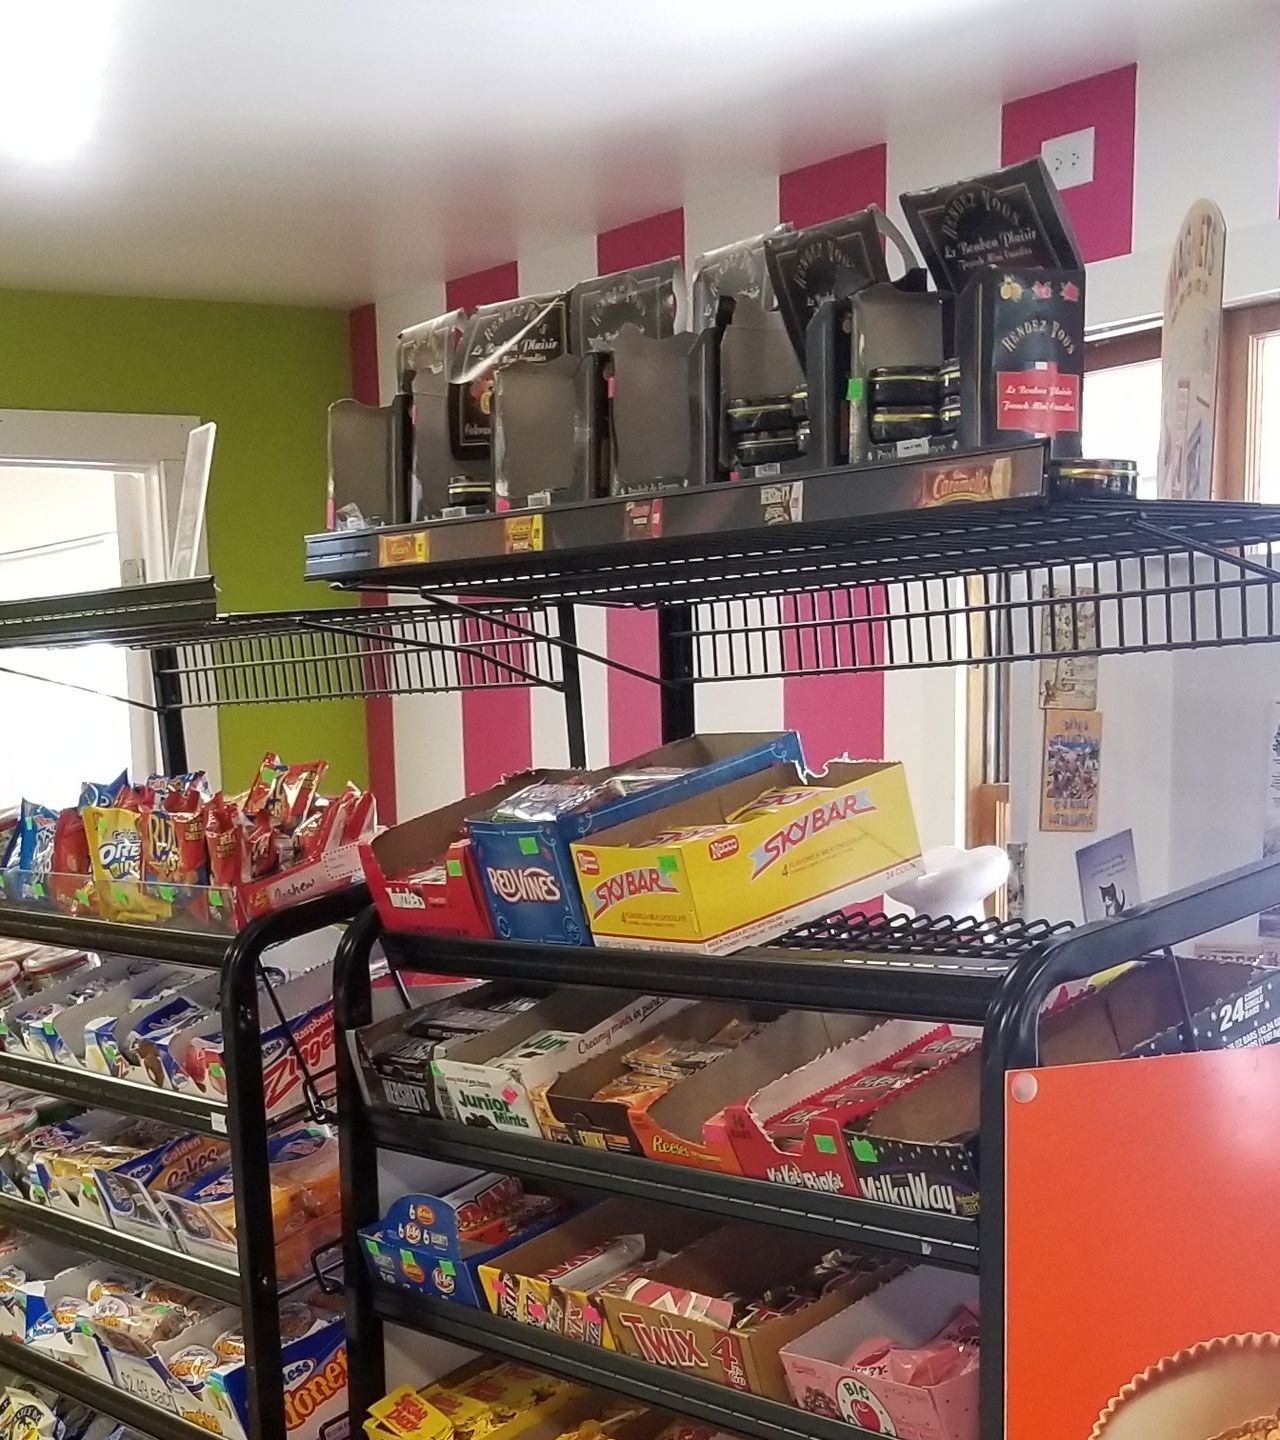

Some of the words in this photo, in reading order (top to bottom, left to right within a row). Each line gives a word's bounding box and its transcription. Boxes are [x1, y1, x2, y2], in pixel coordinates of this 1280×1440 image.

[1001, 319, 1048, 353] RENDEZ
[1051, 320, 1076, 356] VOUS
[98, 842, 141, 866] ORE
[1219, 996, 1246, 1032] 24
[291, 1009, 335, 1044] Raspberr
[577, 1028, 612, 1055] Creamy
[458, 1089, 511, 1112] Junior
[494, 1111, 530, 1129] Mints
[409, 1203, 417, 1220] 6
[398, 1222, 405, 1239] 6
[422, 1229, 431, 1245] 6
[842, 1381, 870, 1401] BIG
